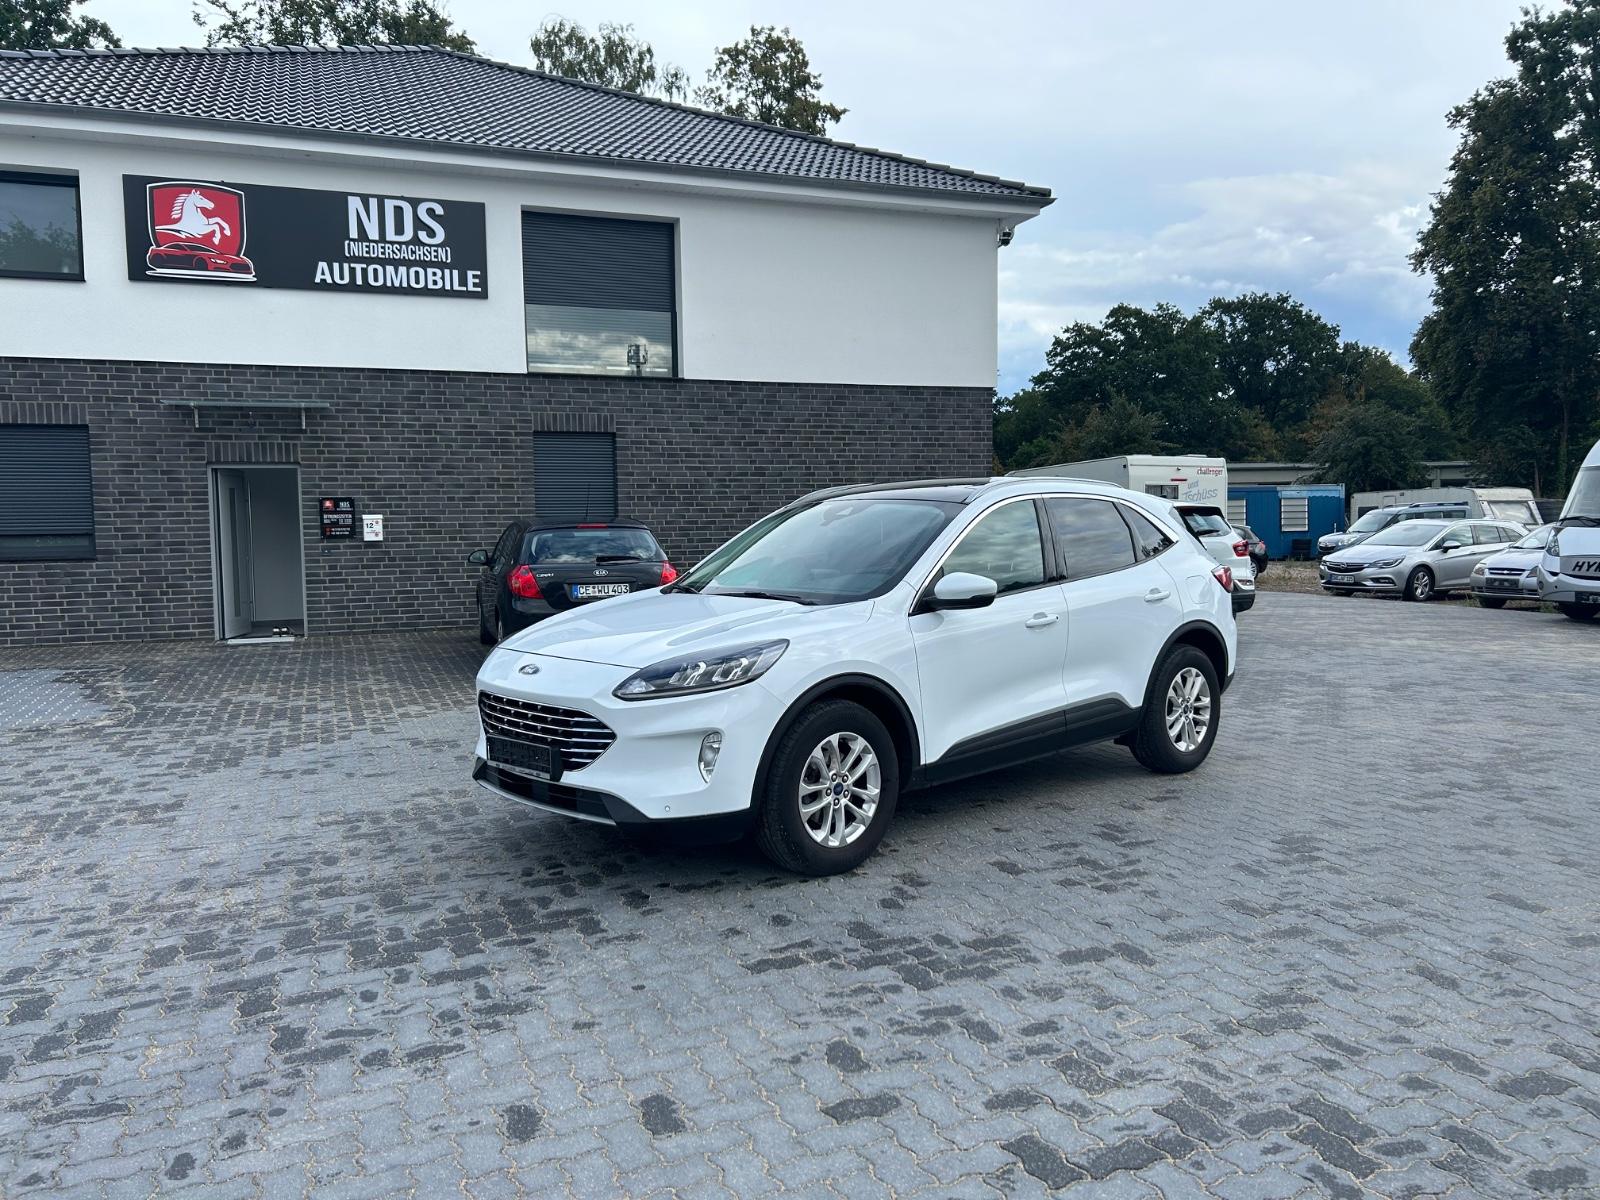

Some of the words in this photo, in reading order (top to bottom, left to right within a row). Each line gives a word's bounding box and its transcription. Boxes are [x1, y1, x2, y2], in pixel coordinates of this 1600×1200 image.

[346, 195, 446, 245] NDS
[314, 260, 482, 292] AUTOMOBILE
[1197, 467, 1223, 477] challenger
[578, 585, 590, 595] CE
[597, 585, 609, 595] WU
[611, 584, 629, 594] 403
